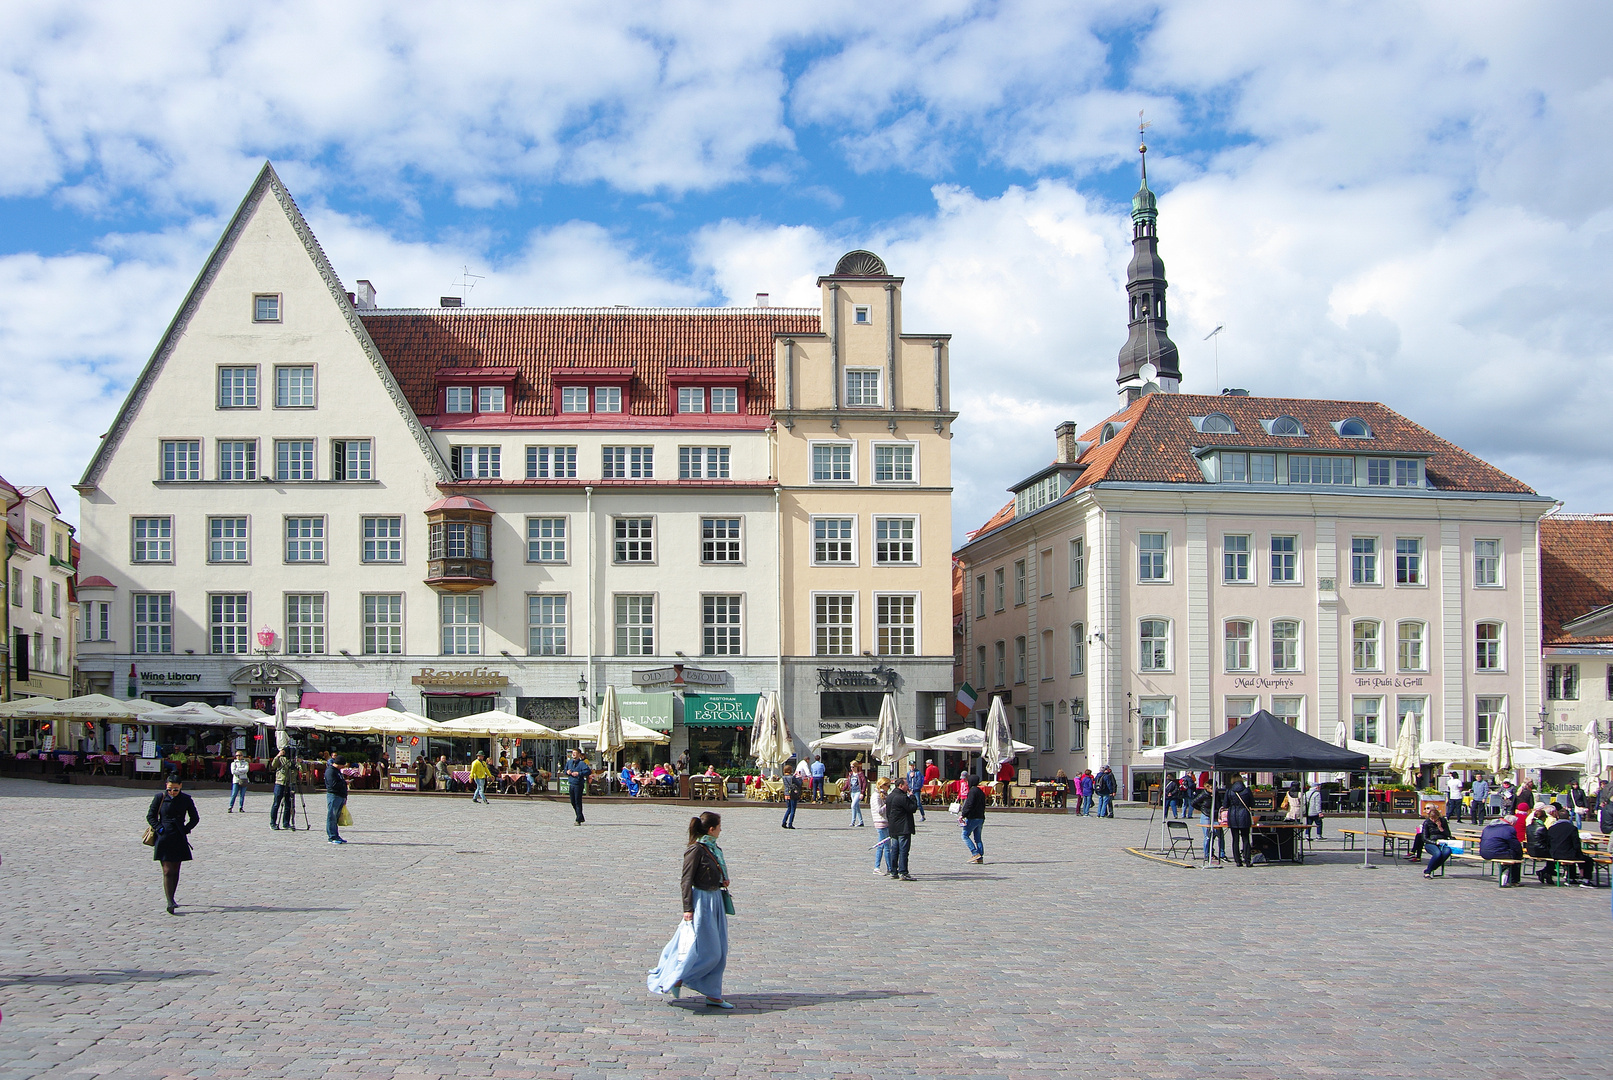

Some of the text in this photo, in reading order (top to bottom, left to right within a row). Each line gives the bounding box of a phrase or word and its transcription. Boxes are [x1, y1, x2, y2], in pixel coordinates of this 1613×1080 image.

[141, 672, 201, 682] Wine Library
[419, 667, 500, 679] Revalia
[686, 671, 722, 682] ESTONIA
[838, 668, 863, 677] Vana
[1234, 678, 1294, 689] Mad Murphy's
[1372, 678, 1392, 689] Pubi
[1394, 678, 1402, 687] &
[1403, 678, 1424, 688] Grill
[704, 702, 742, 712] OLDE
[640, 716, 668, 724] INN
[695, 710, 753, 720] ESTONIA
[1547, 722, 1583, 732] Balthasar
